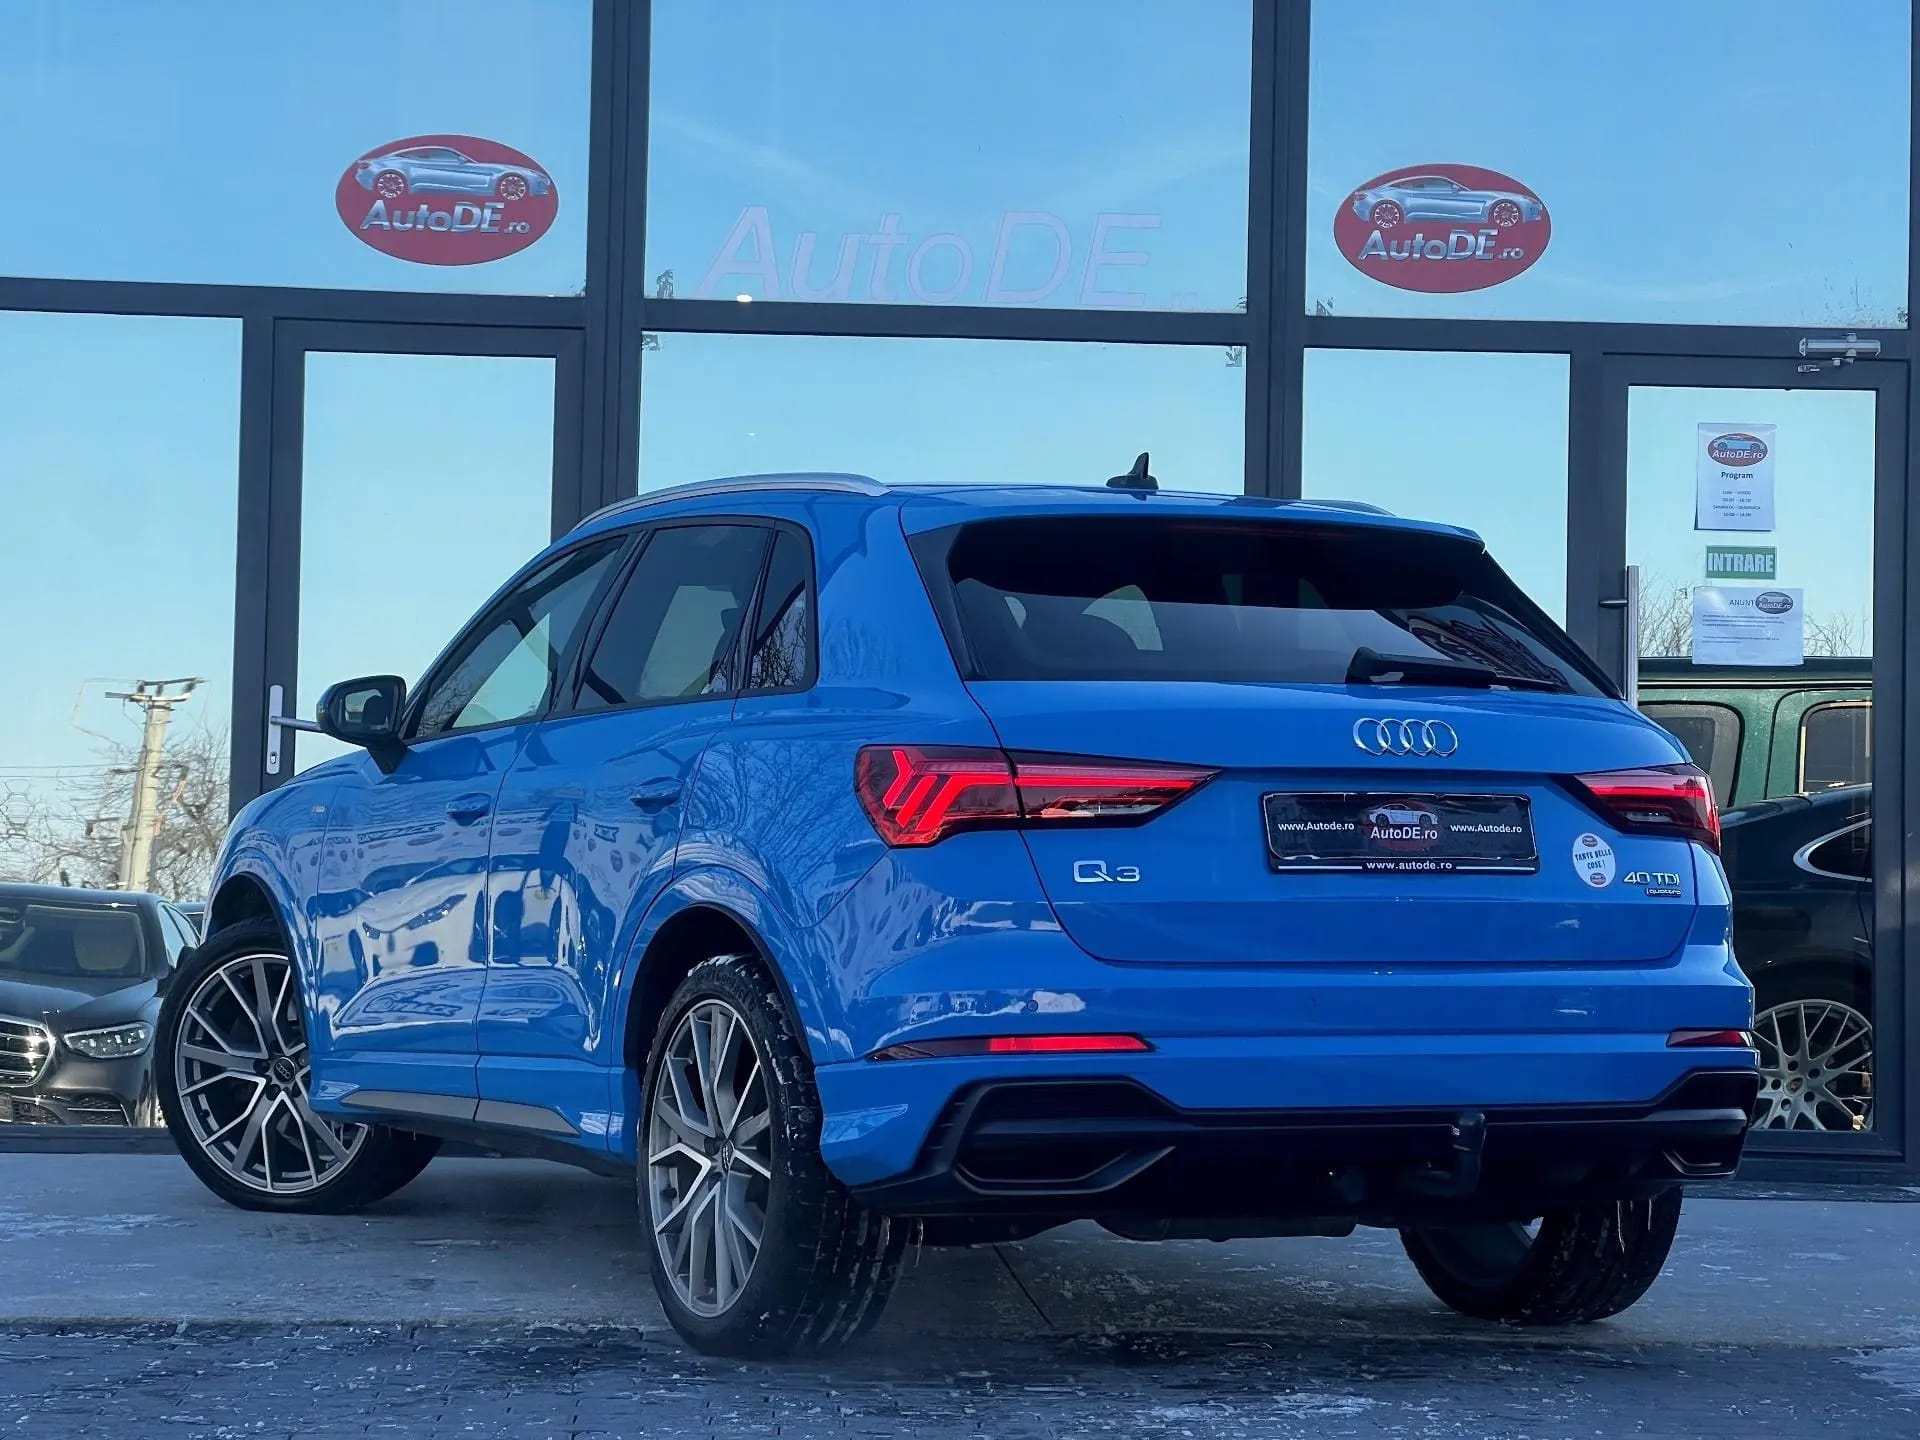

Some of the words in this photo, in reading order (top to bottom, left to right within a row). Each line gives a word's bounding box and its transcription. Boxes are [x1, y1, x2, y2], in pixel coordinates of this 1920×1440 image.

[1711, 449, 1764, 459] AutoDE.ro
[1721, 471, 1754, 480] Program
[1706, 552, 1775, 573] INTRARE
[1277, 821, 1355, 832] www.Autode.ro
[1370, 826, 1439, 839] AutoDE.ro
[1450, 823, 1523, 834] www.Autode.ro
[1574, 851, 1594, 862] TANTE
[1595, 848, 1613, 859] BELLE
[1073, 859, 1140, 883] Q3
[1366, 860, 1453, 870] www.autode.ro
[1623, 871, 1650, 885] 40
[1652, 872, 1680, 886] TDI
